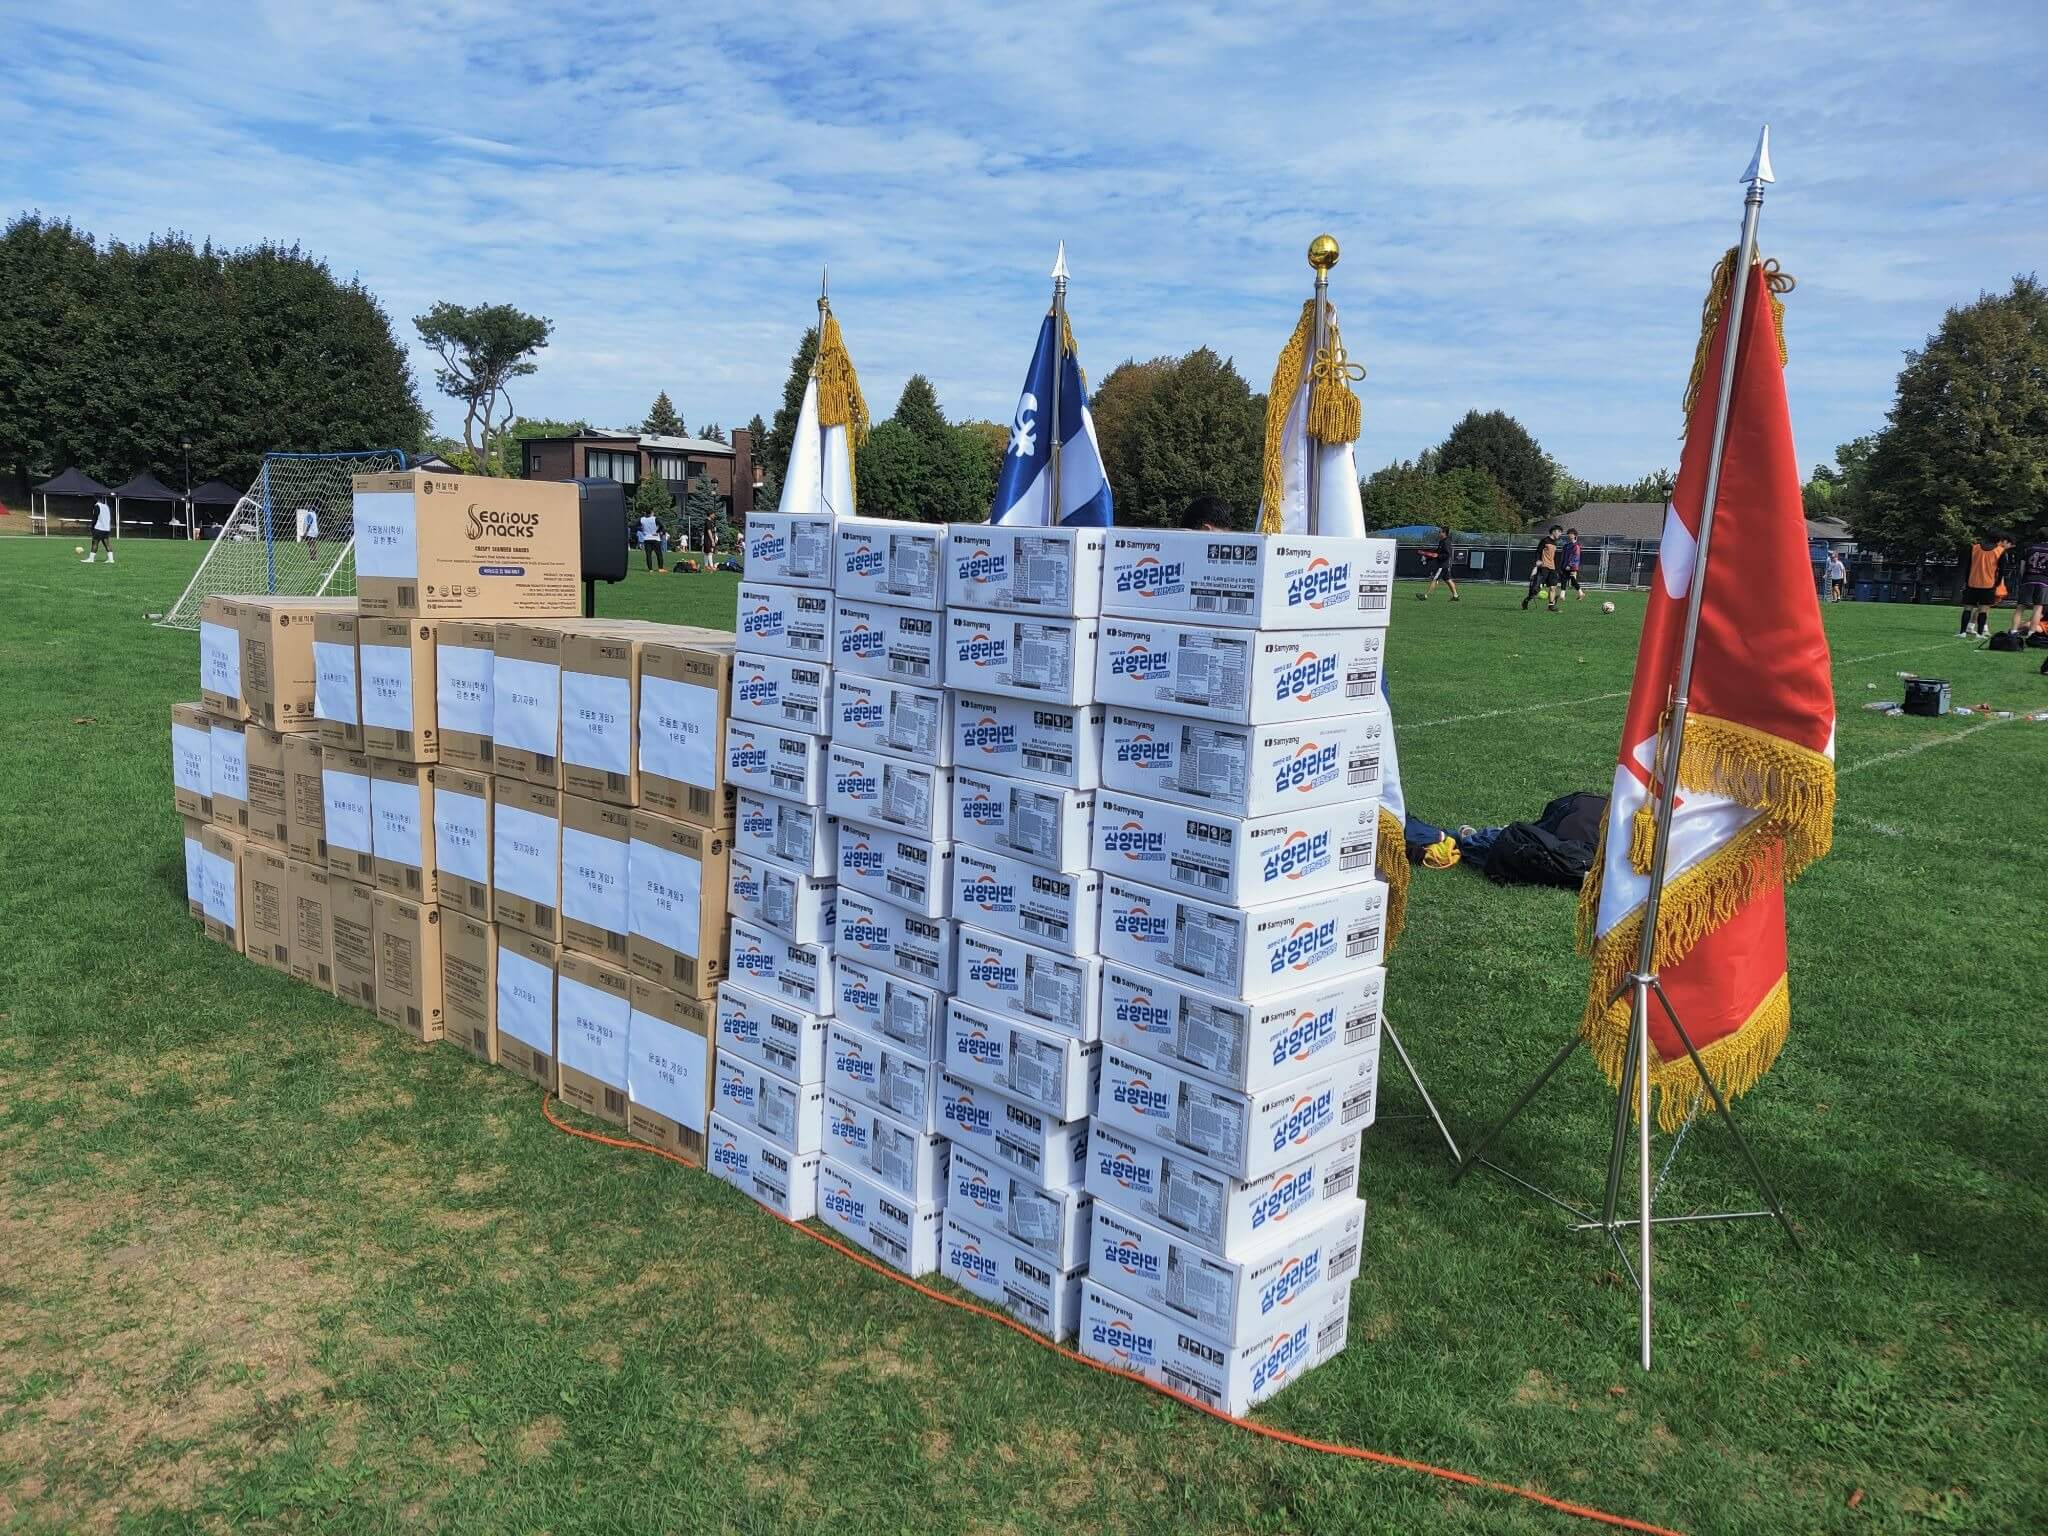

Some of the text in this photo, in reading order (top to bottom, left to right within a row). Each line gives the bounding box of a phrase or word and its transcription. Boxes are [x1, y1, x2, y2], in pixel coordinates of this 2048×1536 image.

[752, 539, 784, 558] 삼양라면
[963, 536, 990, 546] Samyang
[1127, 541, 1160, 551] Samyang
[847, 552, 882, 572] 삼양라면
[1286, 549, 1310, 558] Samyang
[959, 556, 1004, 579] 삼양라면
[1117, 562, 1181, 592] 삼양라면
[1288, 564, 1348, 606] 삼양라면
[744, 612, 782, 632] 삼양라면
[963, 620, 990, 631] Samyang
[842, 631, 883, 651] 삼양라면
[1118, 630, 1151, 641] Samyang
[959, 640, 1005, 661] 삼양라면
[1112, 652, 1167, 674] 삼양라면
[1277, 654, 1336, 700] 삼양라면
[740, 682, 777, 699] 삼양라면
[579, 709, 596, 723] 운동회
[844, 705, 882, 722] 삼양라면
[970, 701, 996, 713] Samyang
[588, 723, 604, 735] 1위팀
[659, 716, 678, 730] 운동회
[1123, 719, 1154, 731] Samyang
[669, 734, 686, 744] 1위팀
[964, 724, 1014, 746] 삼양라면
[1273, 737, 1299, 746] Samyang
[732, 748, 765, 768] 삼양라면
[1118, 742, 1170, 761] 삼양라면
[1276, 744, 1336, 792] 삼양라면
[838, 777, 875, 793] 삼양라면
[967, 780, 990, 792] Samyang
[963, 800, 1001, 818] 삼양라면
[1113, 804, 1143, 818] Samyang
[744, 817, 772, 831] 삼양라면
[1261, 827, 1287, 836] Samyang
[1105, 831, 1161, 851] 삼양라면
[843, 850, 881, 869] 삼양라면
[1264, 831, 1327, 881] 삼양라면
[579, 866, 596, 879] 운동회
[970, 859, 996, 872] Samyang
[588, 882, 603, 894] 1위팀
[647, 881, 665, 895] 운동회
[734, 880, 758, 895] 삼양라면
[963, 882, 1013, 903] 삼양라면
[1121, 887, 1150, 906] Samyang
[657, 898, 673, 911] 1위팀
[1115, 915, 1166, 935] 삼양라면
[1267, 918, 1294, 928] Samyang
[843, 925, 887, 943] 삼양라면
[976, 942, 1002, 956] Samyang
[1271, 920, 1334, 973] 삼양라면
[737, 955, 773, 970] 삼양라면
[970, 964, 1016, 983] 삼양라면
[1122, 979, 1152, 997] Samyang
[843, 989, 878, 1007] 삼양라면
[576, 1016, 595, 1032] 운동회
[962, 1014, 988, 1031] Samyang
[1116, 1004, 1168, 1026] 삼양라면
[1270, 1009, 1296, 1021] Samyang
[724, 1019, 758, 1036] 삼양라면
[1274, 1008, 1333, 1065] 삼양라면
[586, 1033, 602, 1046] 1위팀
[958, 1037, 1001, 1058] 삼양라면
[648, 1052, 667, 1068] 운동회
[837, 1058, 873, 1076] 삼양라면
[659, 1070, 675, 1085] 1위팀
[1120, 1061, 1152, 1080] Samyang
[722, 1078, 753, 1100] 삼양라면
[951, 1078, 974, 1095] Samyang
[1114, 1087, 1167, 1110] 삼양라면
[1270, 1095, 1295, 1109] Samyang
[944, 1102, 989, 1127] 삼양라면
[1273, 1090, 1330, 1152] 삼양라면
[832, 1122, 866, 1141] 삼양라면
[1107, 1134, 1137, 1154] Samyang
[714, 1148, 747, 1169] 삼양라면
[964, 1158, 988, 1177] Samyang
[1100, 1159, 1150, 1185] 삼양라면
[1249, 1172, 1275, 1187] Samyang
[960, 1180, 1000, 1204] 삼양라면
[1252, 1168, 1311, 1229] 삼양라면
[825, 1194, 864, 1218] 삼양라면
[957, 1226, 981, 1244] Samyang
[1111, 1221, 1142, 1241] Samyang
[951, 1249, 996, 1277] 삼양라면
[1105, 1244, 1160, 1271] 삼양라면
[1259, 1259, 1282, 1275] Samyang
[1262, 1250, 1318, 1315] 삼양라면
[1102, 1299, 1133, 1320] Samyang
[1093, 1324, 1153, 1355] 삼양라면
[1250, 1336, 1273, 1352] Samyang
[1253, 1324, 1307, 1392] 삼양라면
